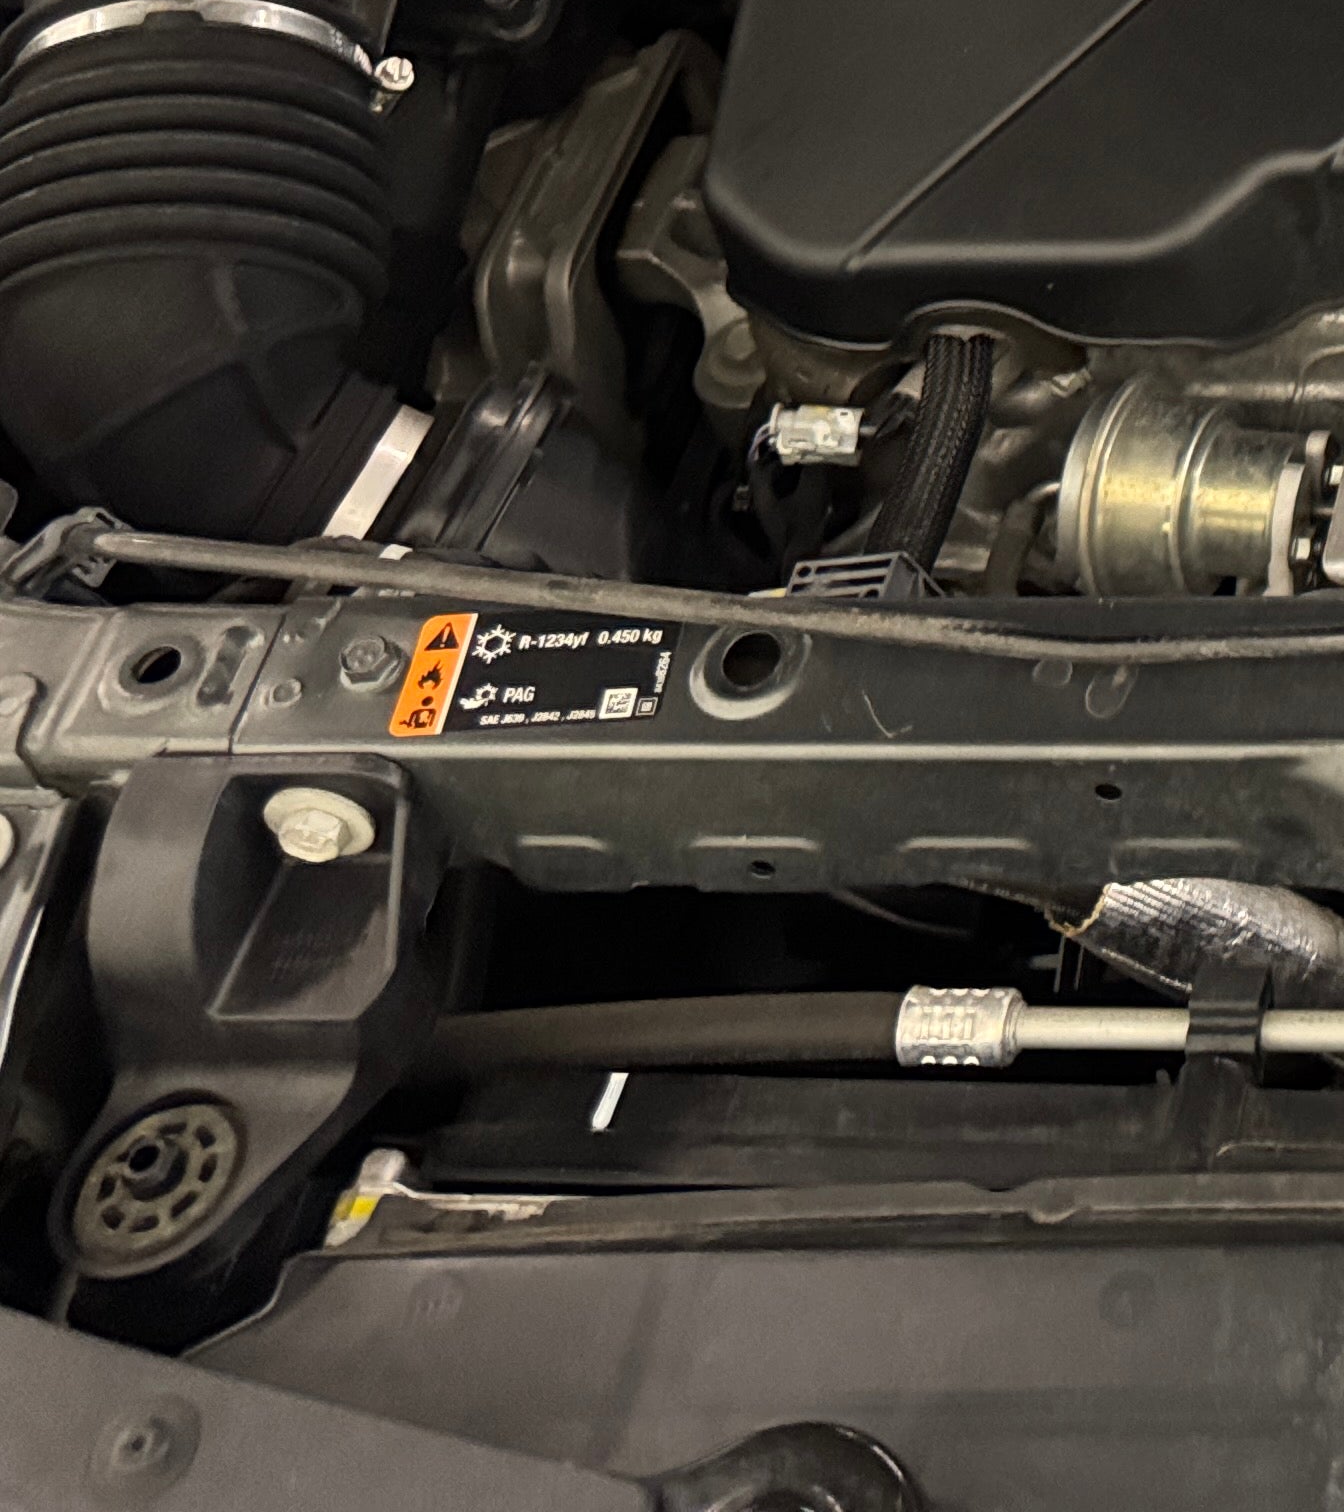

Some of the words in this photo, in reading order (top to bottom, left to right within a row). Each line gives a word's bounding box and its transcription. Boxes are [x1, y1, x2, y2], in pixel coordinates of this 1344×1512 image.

[517, 631, 590, 650] R-1234yf
[598, 630, 640, 645] 0.450
[643, 629, 663, 645] kg
[503, 686, 536, 703] PAG
[479, 714, 501, 726] SAE
